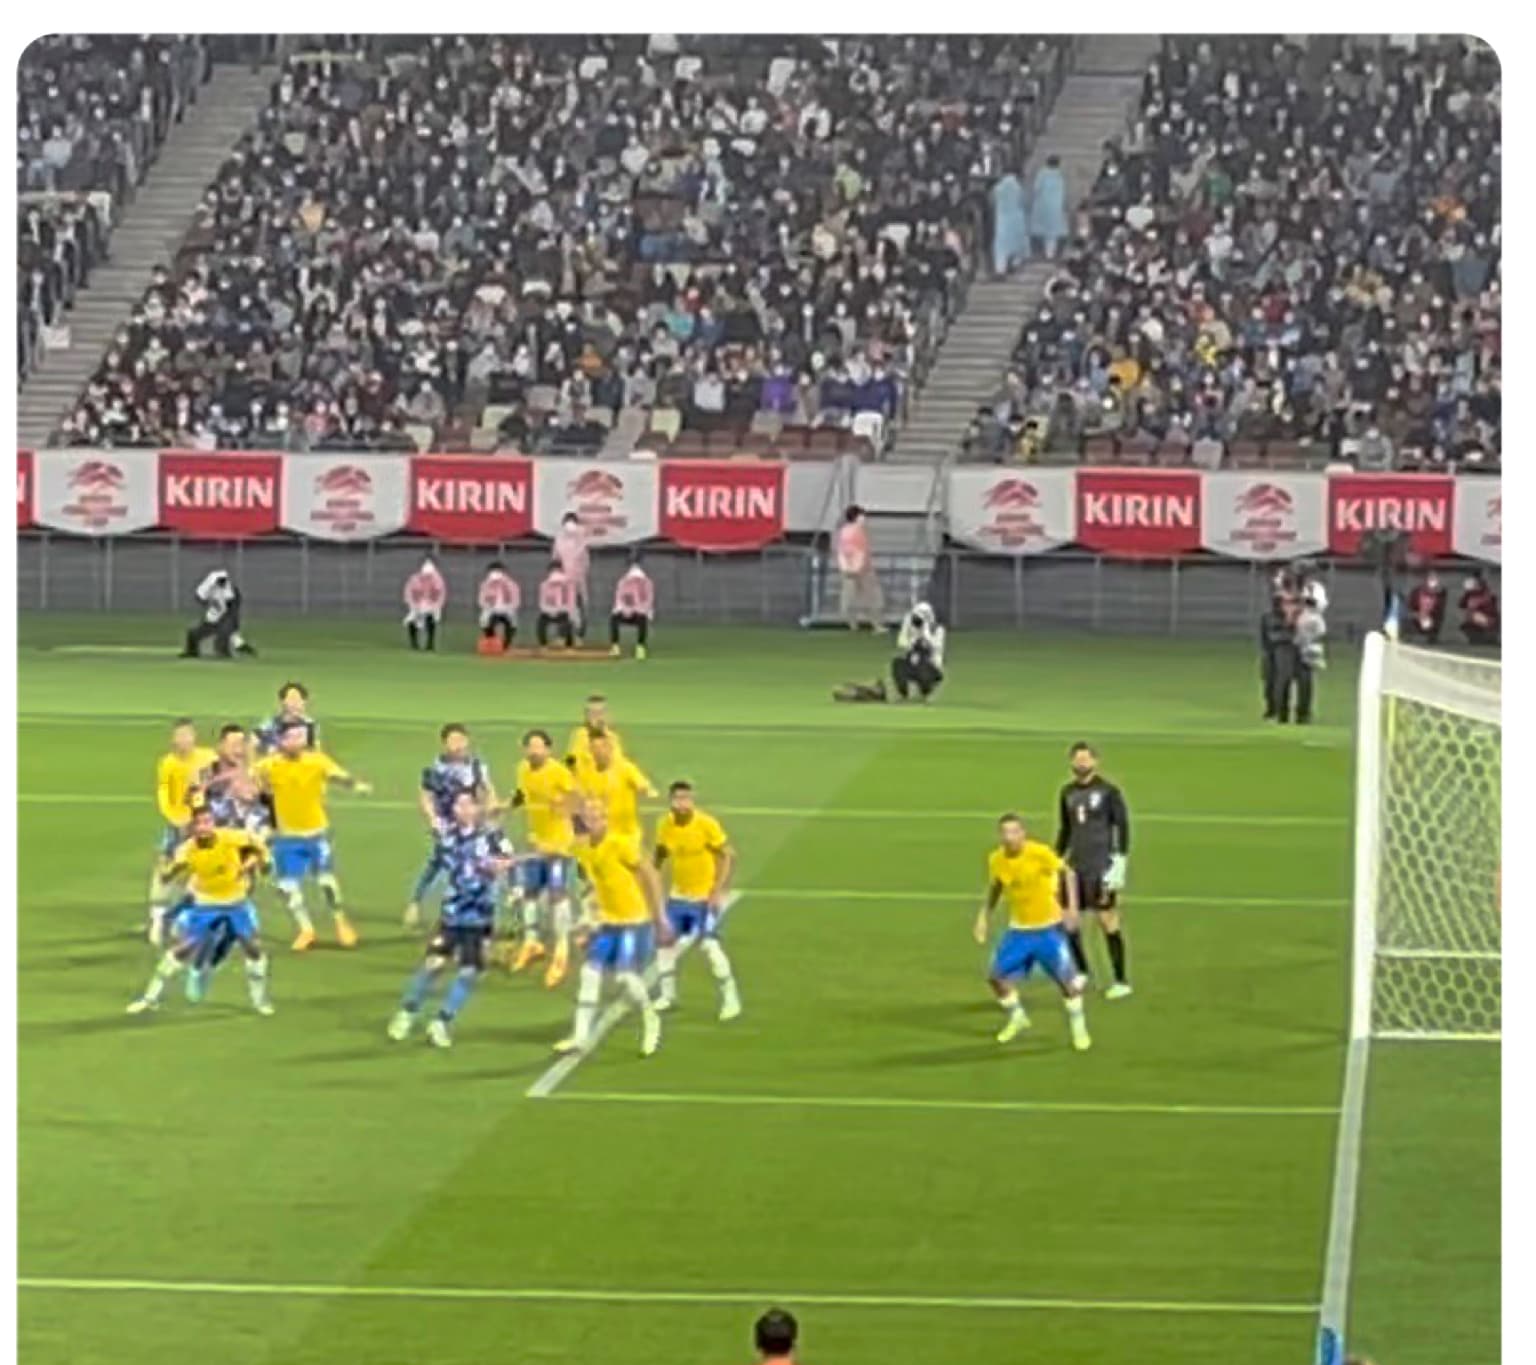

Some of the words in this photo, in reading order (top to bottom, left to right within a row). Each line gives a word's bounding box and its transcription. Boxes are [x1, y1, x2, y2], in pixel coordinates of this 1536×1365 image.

[167, 475, 273, 509] KIRIN
[416, 478, 525, 513] KIRIN
[666, 484, 775, 519] KIRIN
[1083, 492, 1193, 527] KIRIN
[1336, 497, 1446, 531] KIRIN
